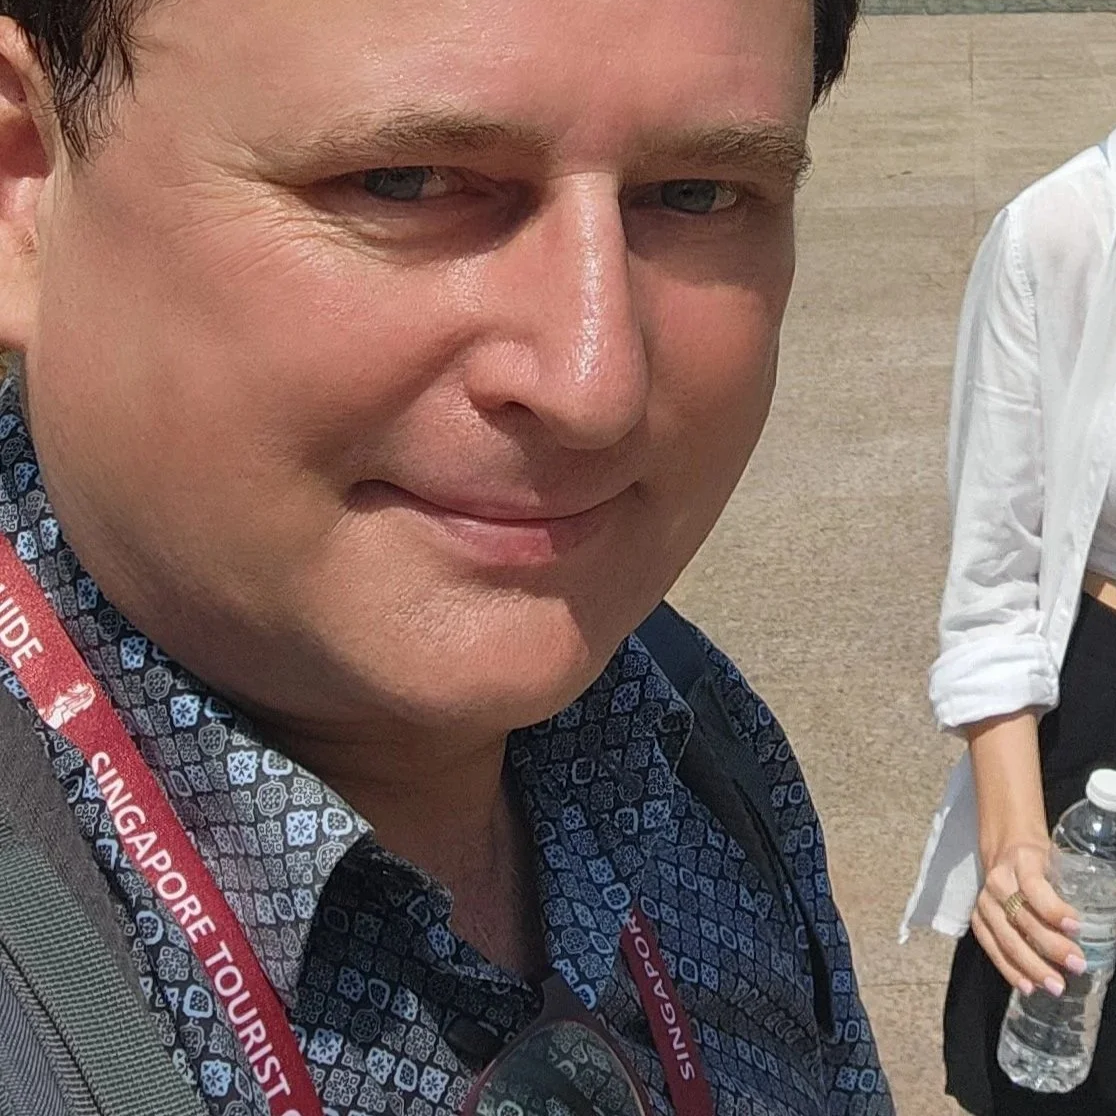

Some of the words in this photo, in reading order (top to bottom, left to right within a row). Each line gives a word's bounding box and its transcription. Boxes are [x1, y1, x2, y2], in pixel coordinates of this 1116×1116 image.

[90, 751, 217, 944] SINGAPORE
[205, 941, 291, 1098] TOURIST
[626, 909, 696, 1081] SINGAPOR
